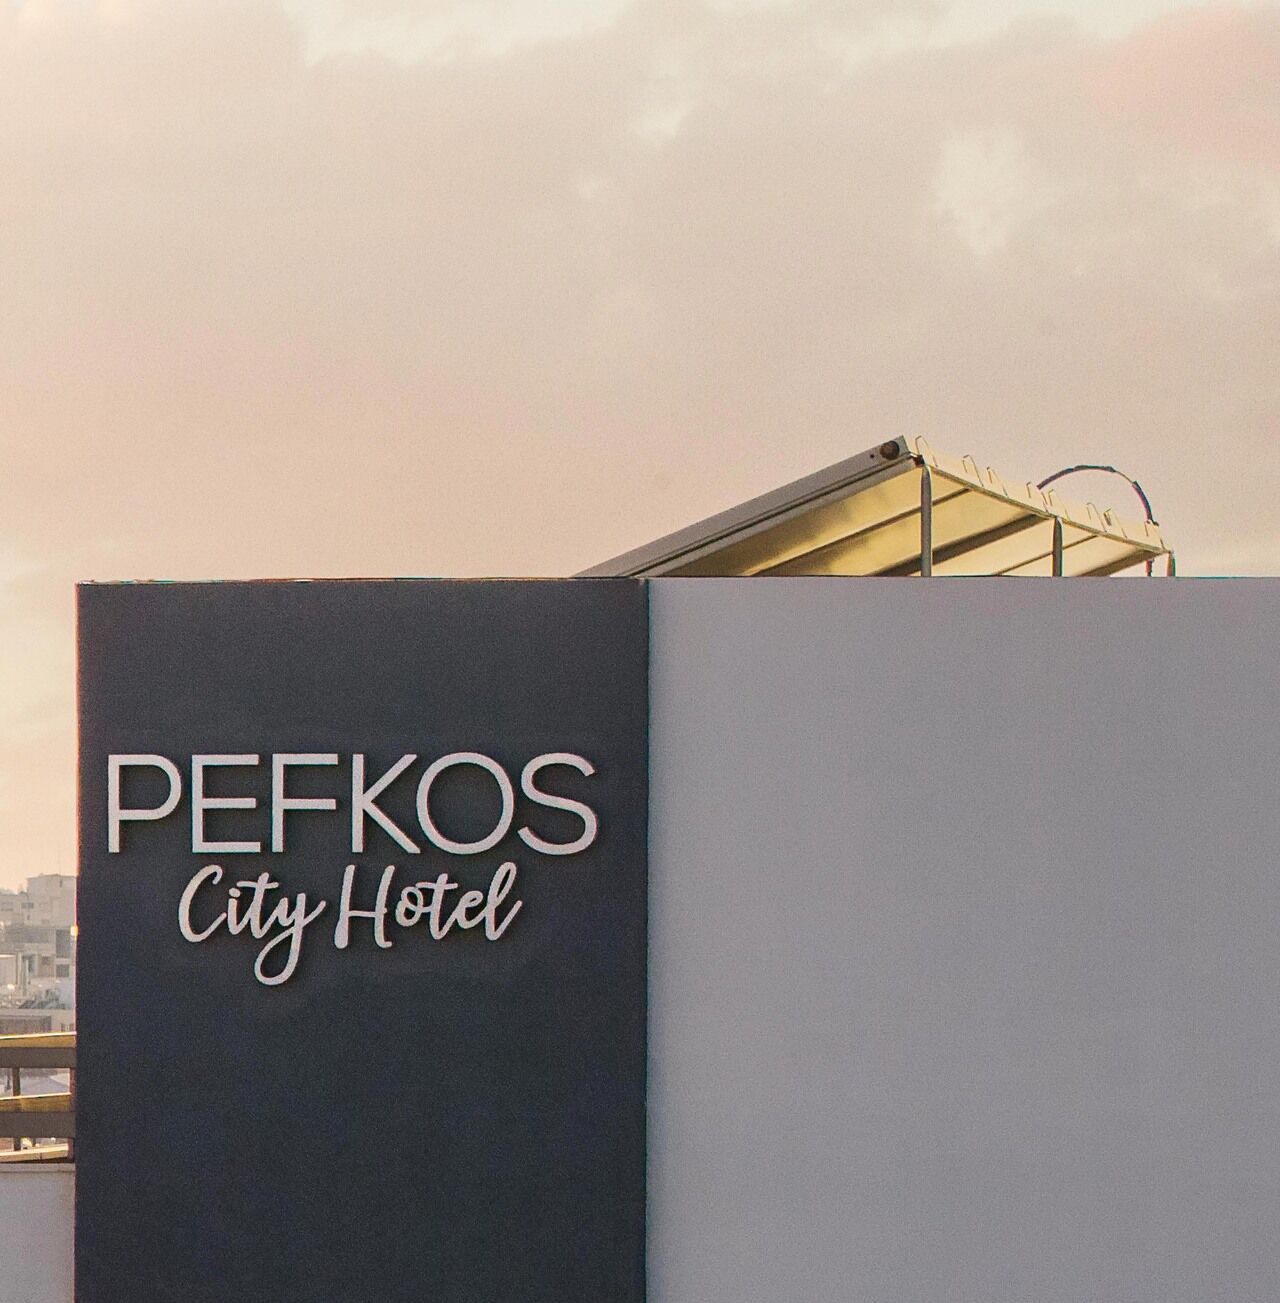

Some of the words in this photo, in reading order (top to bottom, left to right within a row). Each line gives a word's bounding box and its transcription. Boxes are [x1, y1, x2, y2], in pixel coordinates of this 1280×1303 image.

[107, 752, 597, 855] PEFKOS
[178, 864, 327, 986] City
[334, 861, 523, 949] Hotel
